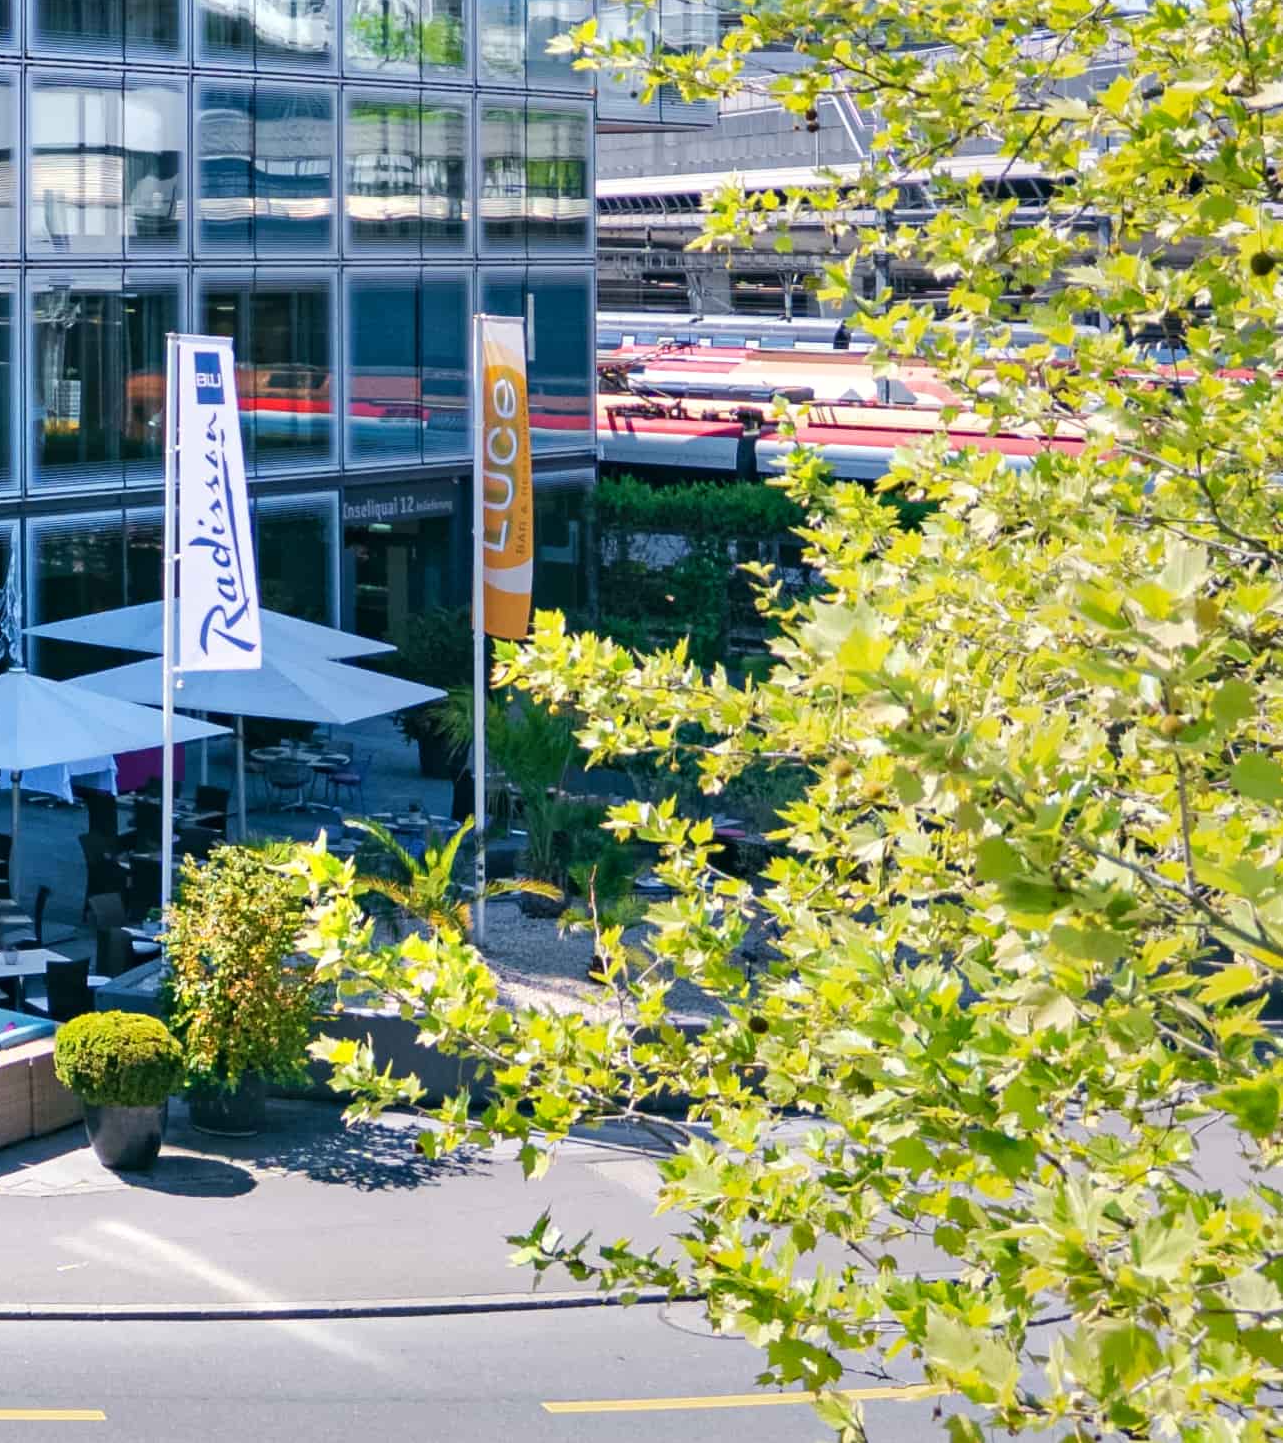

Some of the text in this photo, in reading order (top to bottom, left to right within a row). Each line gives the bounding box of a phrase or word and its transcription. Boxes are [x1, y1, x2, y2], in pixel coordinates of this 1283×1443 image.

[196, 372, 221, 388] BLU
[400, 495, 414, 513] 12
[189, 412, 256, 656] Radisson
